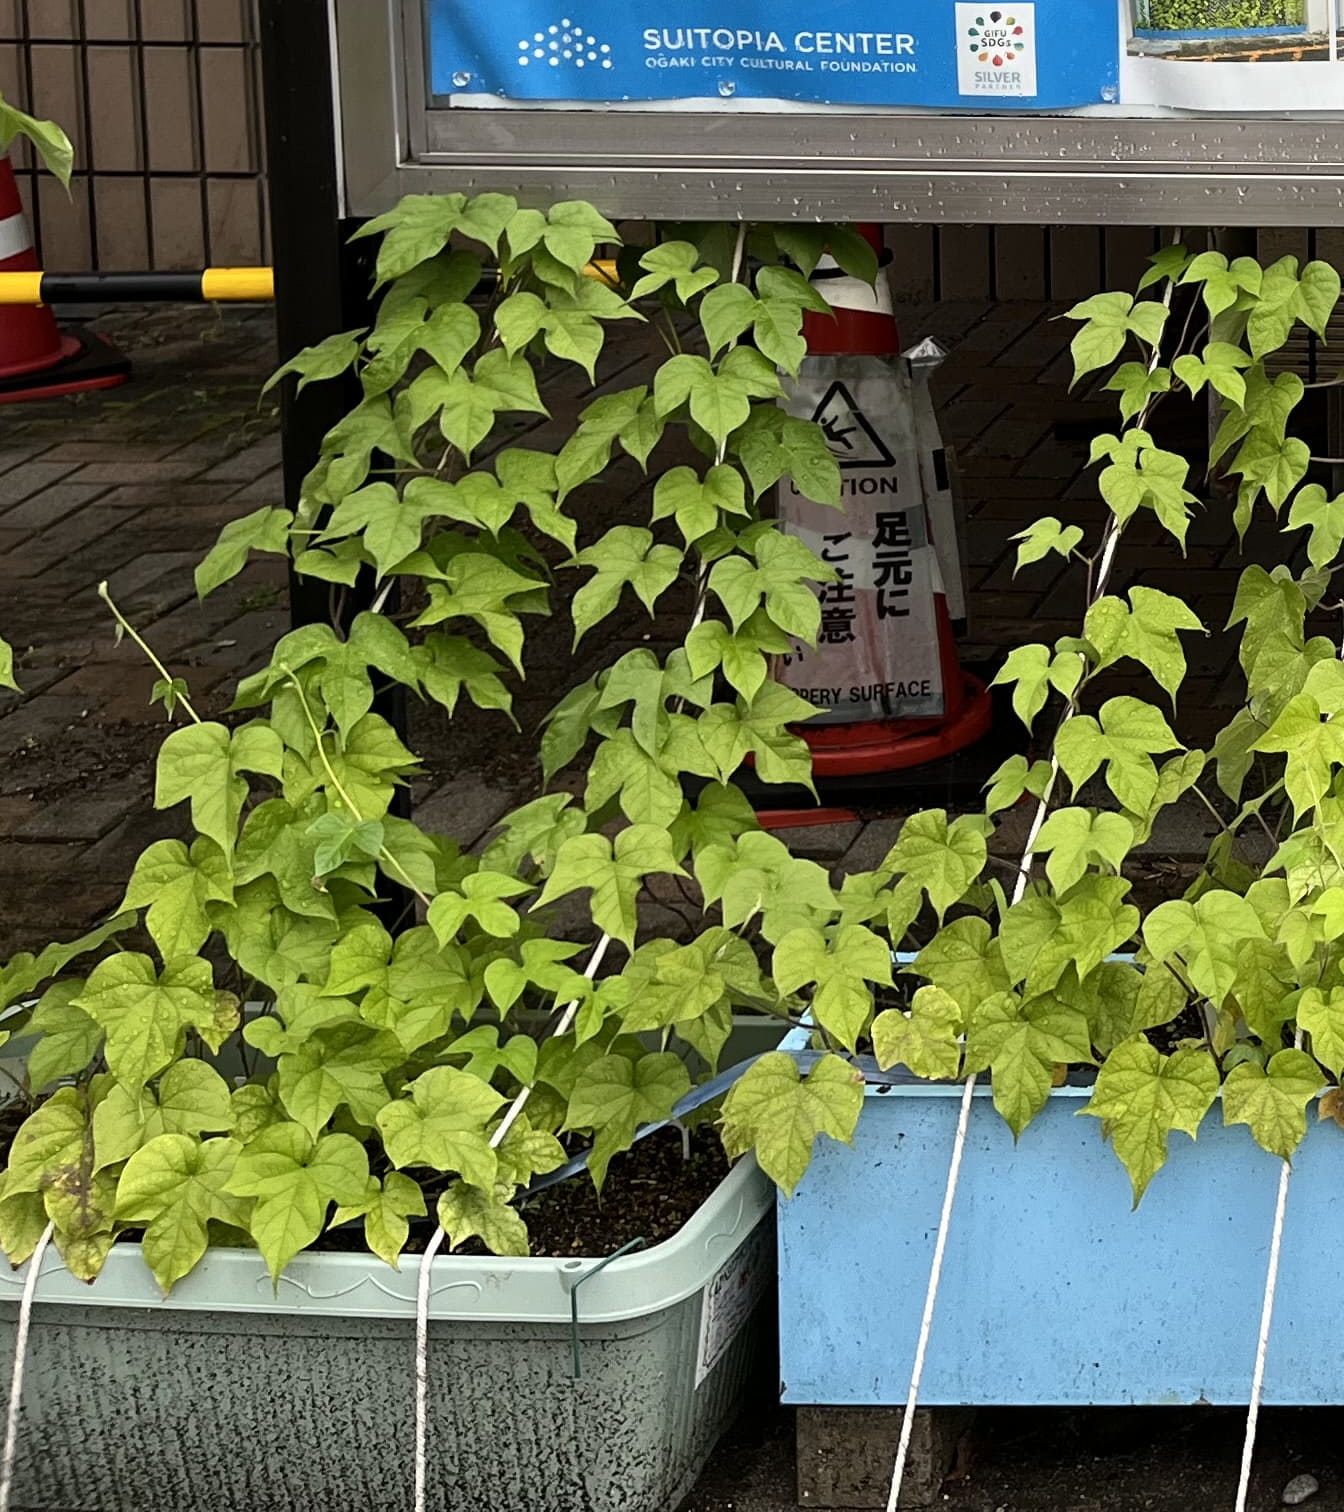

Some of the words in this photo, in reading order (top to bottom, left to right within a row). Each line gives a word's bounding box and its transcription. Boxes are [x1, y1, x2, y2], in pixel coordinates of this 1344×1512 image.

[643, 28, 784, 53] SUITOPIA
[795, 31, 915, 56] CENTER
[981, 37, 1012, 47] SDGs
[984, 29, 1007, 38] GIFU
[645, 55, 696, 69] OGAKI
[701, 56, 735, 69] CITY
[740, 58, 813, 72] CULTURAL
[820, 60, 917, 74] FOUNDATION
[975, 71, 1021, 83] SILVER
[872, 510, 912, 619] 足元に
[849, 679, 931, 703] SURFACE
